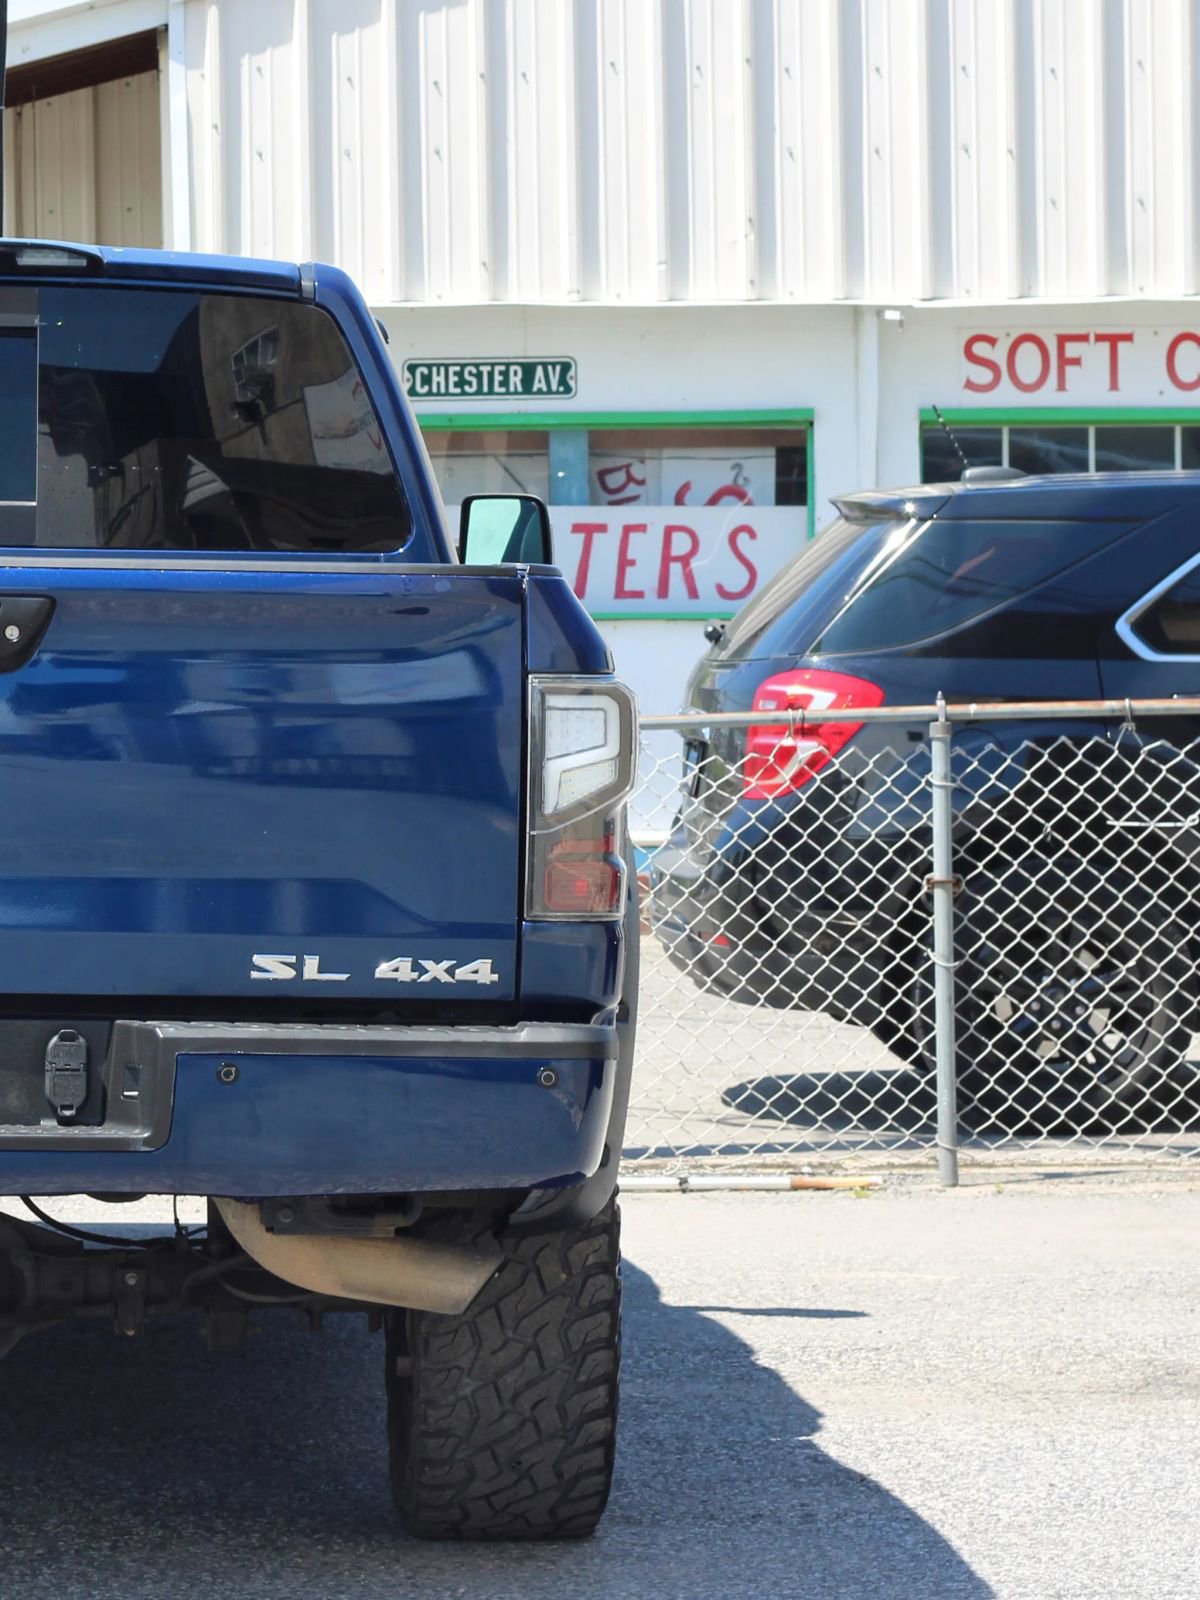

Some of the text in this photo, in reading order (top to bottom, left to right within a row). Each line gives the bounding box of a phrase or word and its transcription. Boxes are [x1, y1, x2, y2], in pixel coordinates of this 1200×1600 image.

[963, 331, 1134, 393] SOFT
[414, 364, 564, 394] CHESTER AV.
[250, 953, 351, 981] SL
